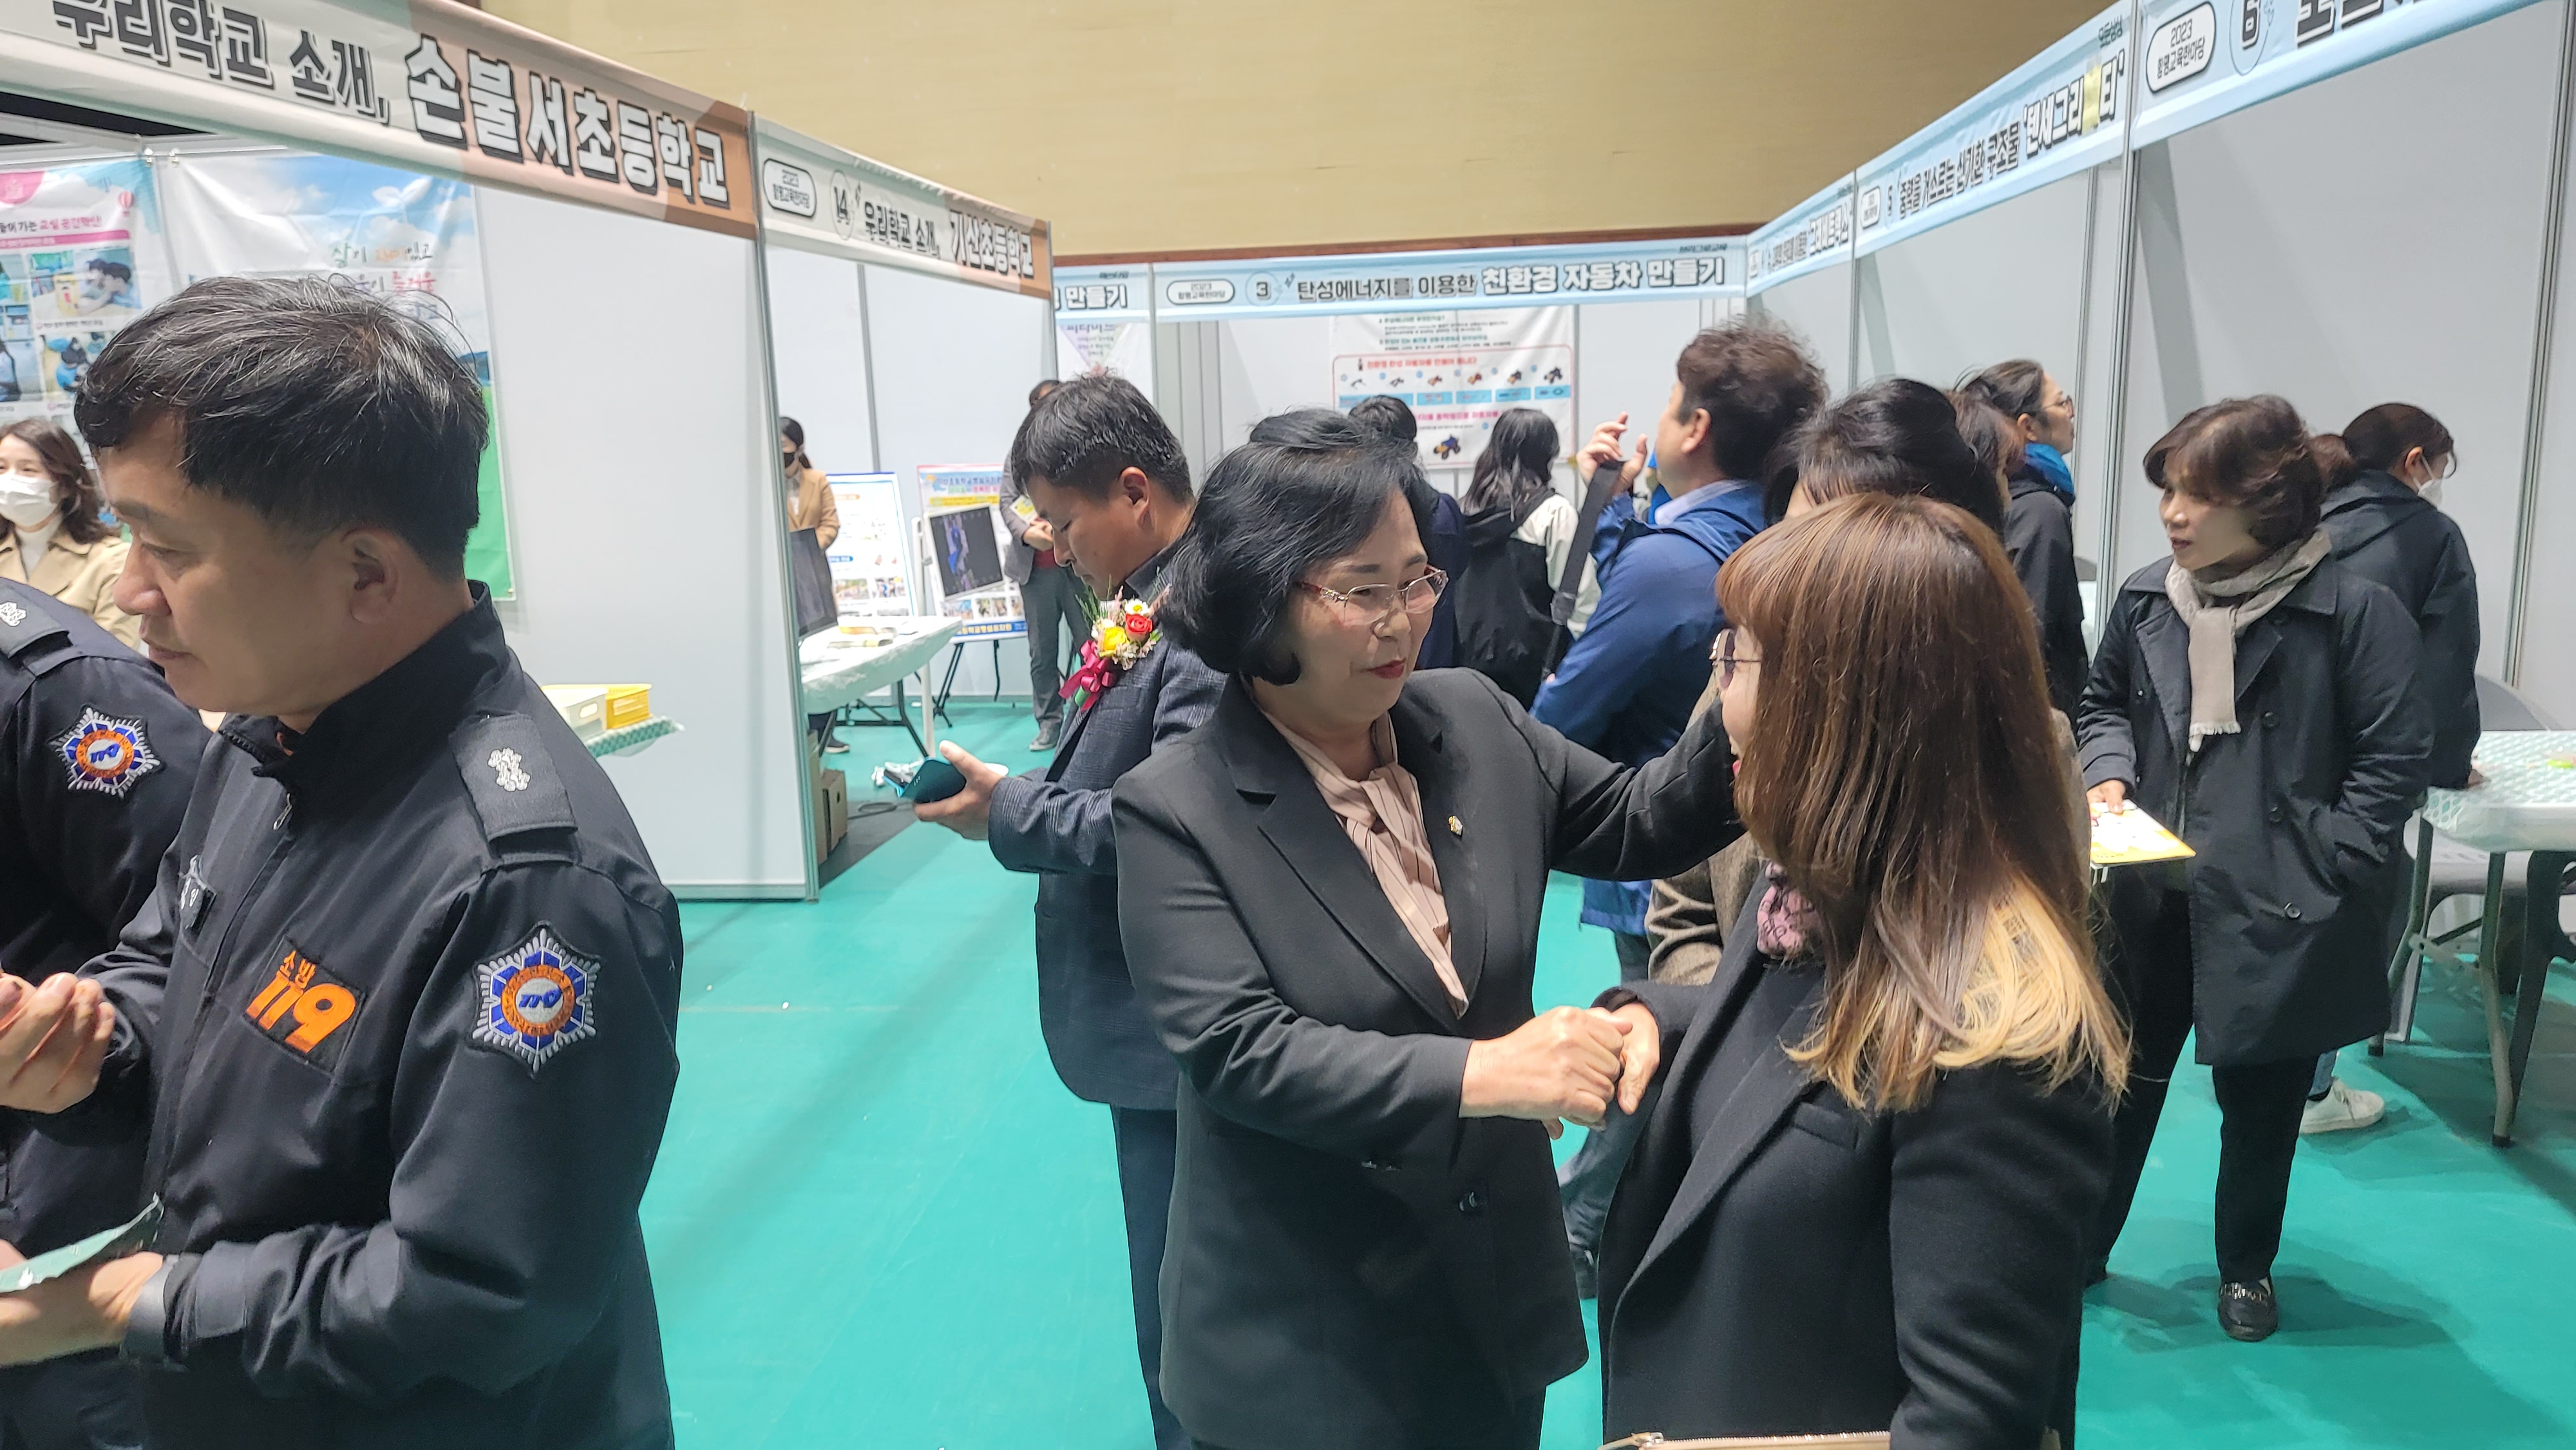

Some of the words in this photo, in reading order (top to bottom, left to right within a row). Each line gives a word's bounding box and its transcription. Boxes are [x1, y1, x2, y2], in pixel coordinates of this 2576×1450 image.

[2170, 18, 2193, 48] 2023
[2157, 35, 2206, 79] 함평교육한마당
[289, 30, 390, 126] 소개,
[404, 34, 730, 209] 손불서초등학교
[1956, 137, 1985, 194] 신기한
[1987, 121, 2021, 180] 구조물
[864, 202, 913, 249] 우리학교
[950, 209, 1034, 279] 기산초등학교
[1065, 283, 1128, 310] 만들기
[1256, 281, 1271, 300] 3
[1418, 274, 1479, 298] 이용한
[1482, 264, 1558, 295] 친환경
[1563, 260, 1642, 291] 자동차
[1646, 256, 1725, 288] 만들기
[279, 950, 316, 989] 소방
[246, 970, 356, 1054] 119
